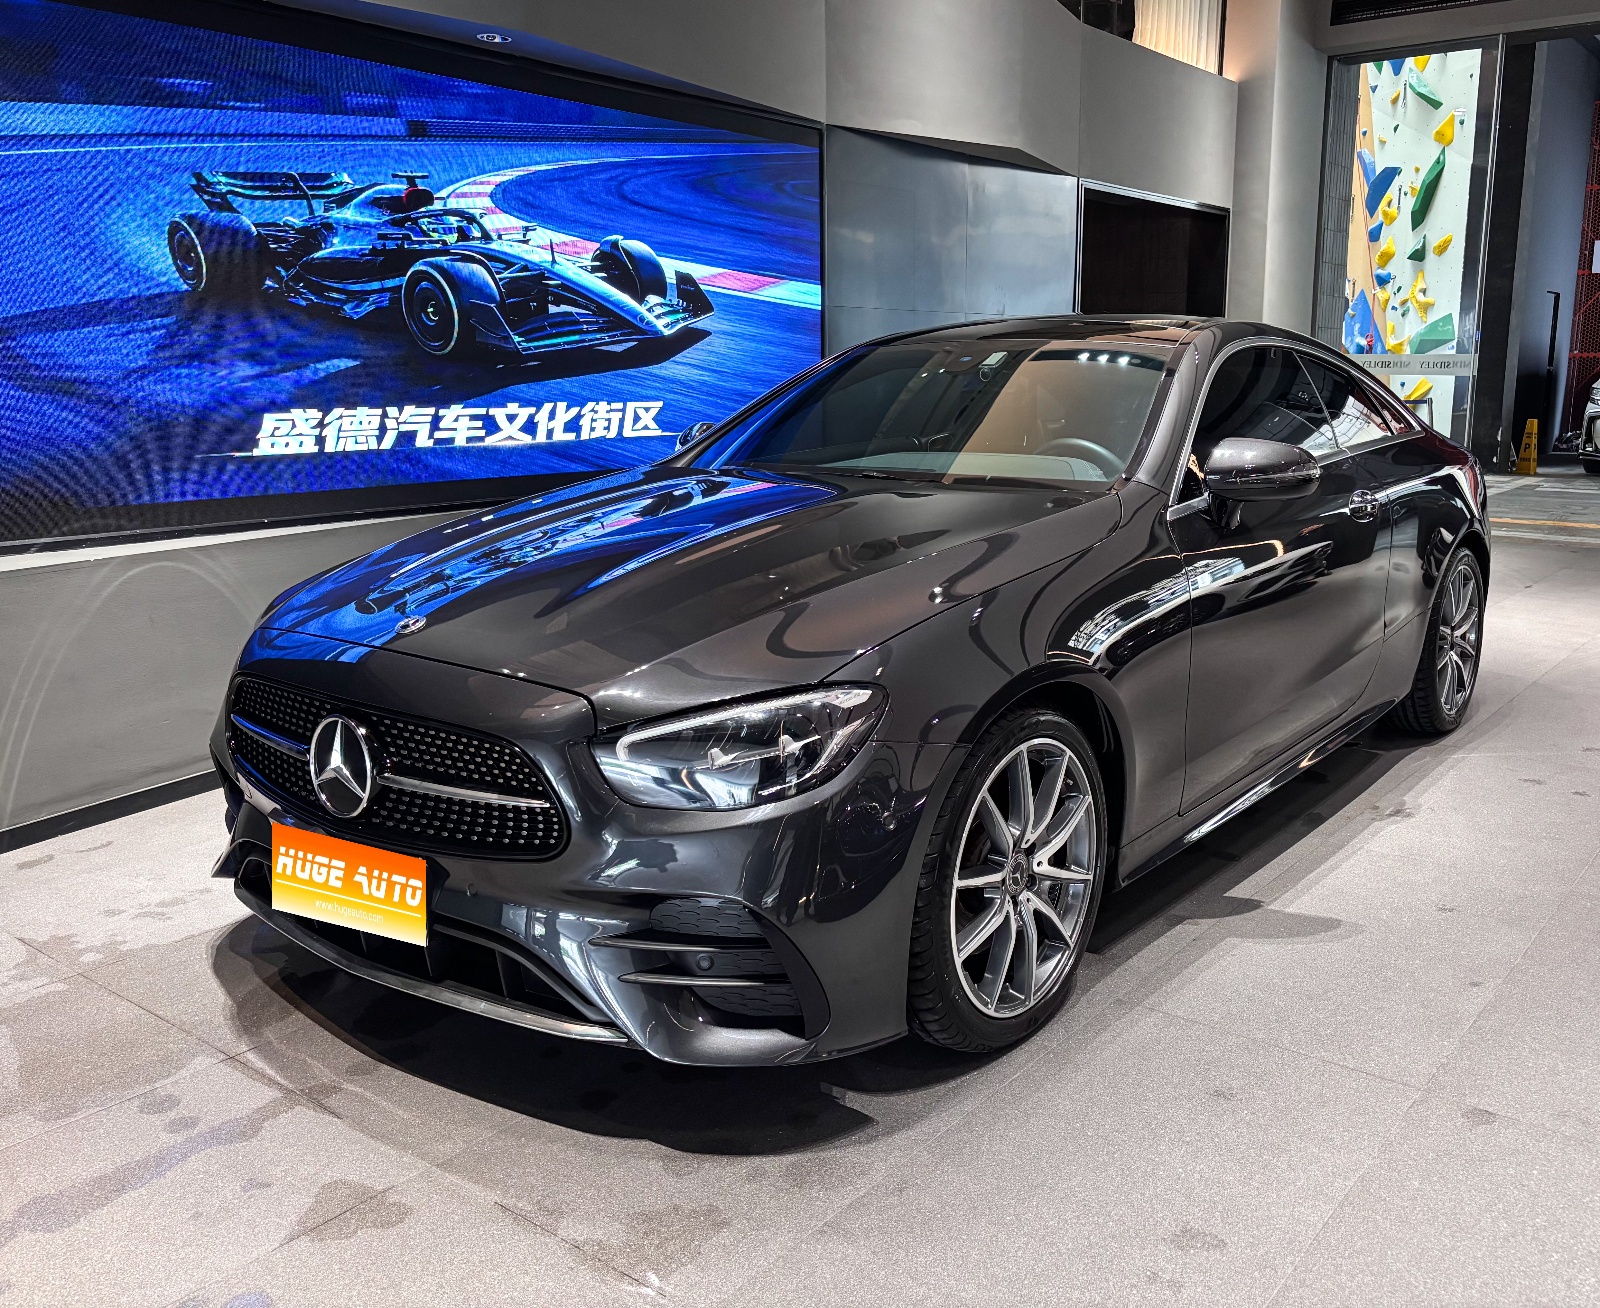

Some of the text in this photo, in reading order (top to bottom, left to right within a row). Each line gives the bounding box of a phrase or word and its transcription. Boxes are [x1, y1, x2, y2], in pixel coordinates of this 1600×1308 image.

[253, 401, 664, 454] 盛德汽车文化街区
